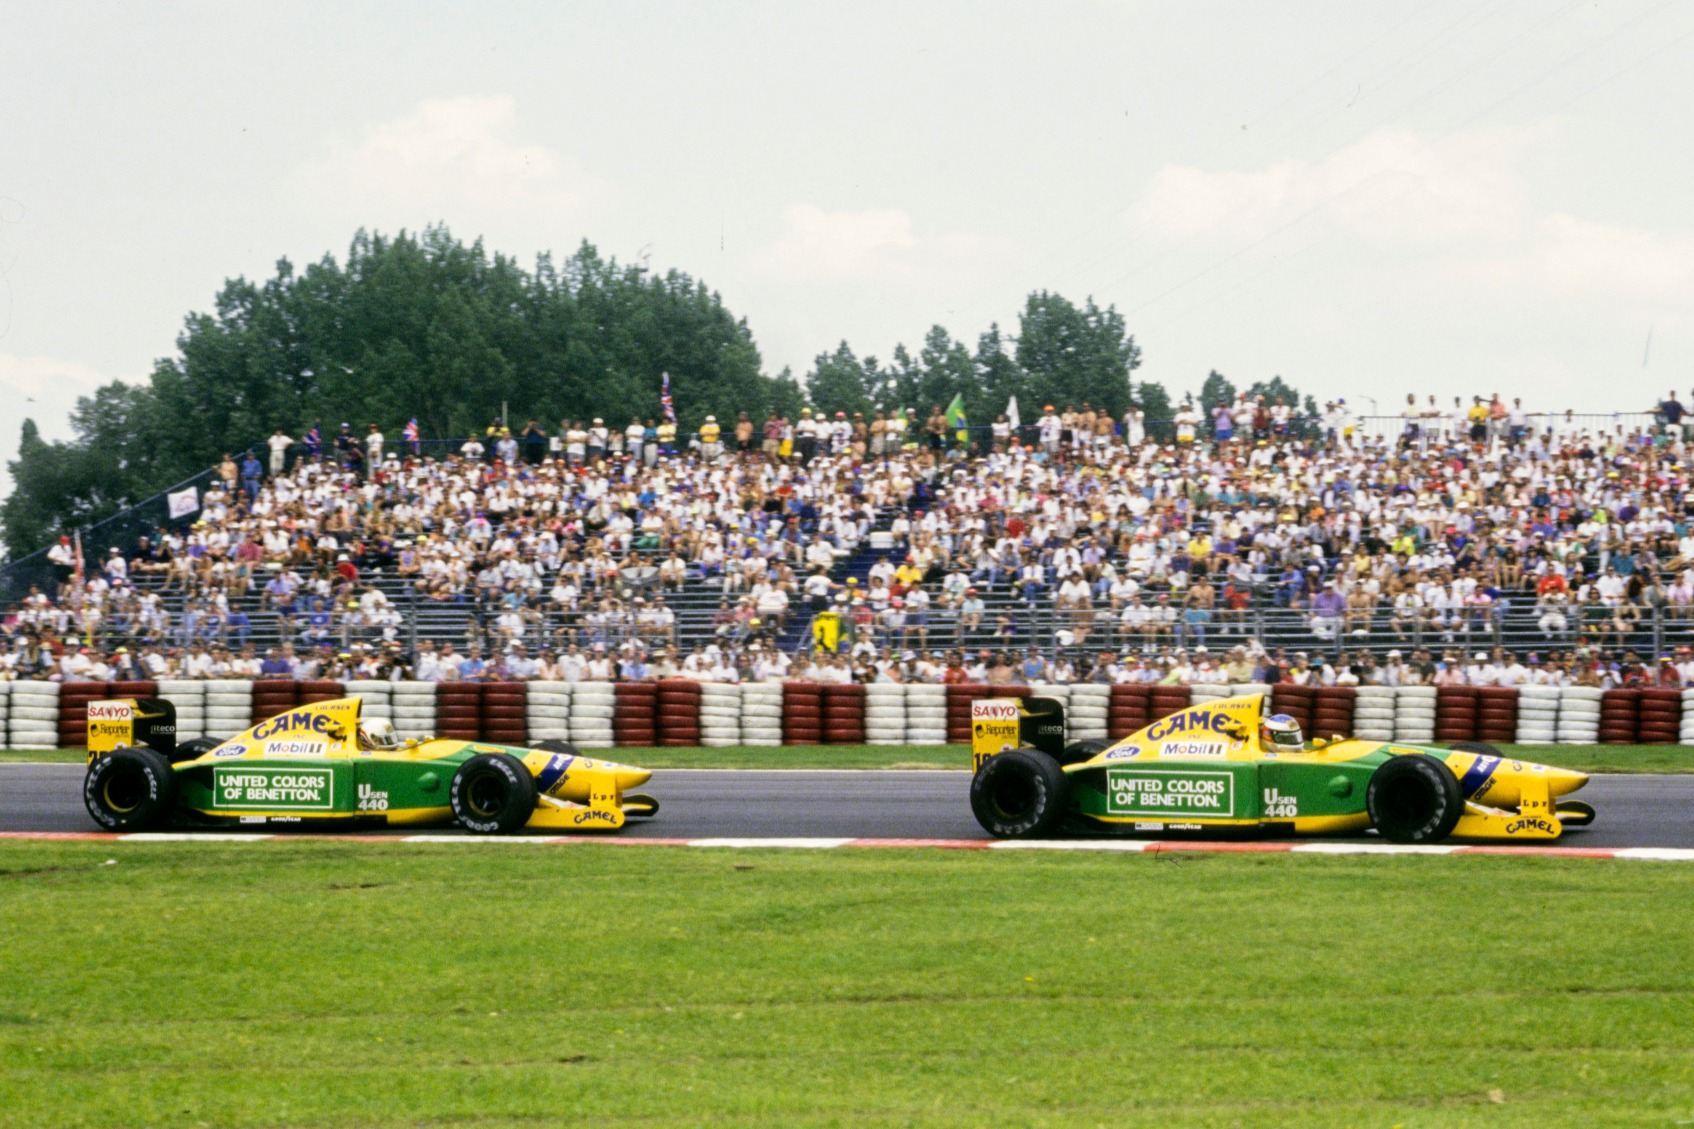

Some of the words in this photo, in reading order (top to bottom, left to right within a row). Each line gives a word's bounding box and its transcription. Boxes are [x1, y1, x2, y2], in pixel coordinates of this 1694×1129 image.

[88, 706, 130, 718] SANYO
[973, 706, 1016, 717] SANYO
[252, 712, 342, 740] CAME
[1147, 711, 1243, 741] CAME
[268, 742, 308, 753] Mobil
[1164, 743, 1207, 755] Mobil
[219, 775, 267, 787] UNITED
[272, 776, 325, 788] COLORS
[1111, 779, 1162, 791] UNITED
[1167, 780, 1224, 793] COLORS
[224, 788, 242, 799] OF
[247, 789, 321, 801] BENETTON.
[1116, 792, 1135, 805] OF
[1140, 794, 1220, 807] BENETTON.
[358, 799, 388, 810] 440
[1265, 805, 1297, 816] 440
[574, 811, 617, 824] CAMEL
[1506, 819, 1555, 834] CAMEL
